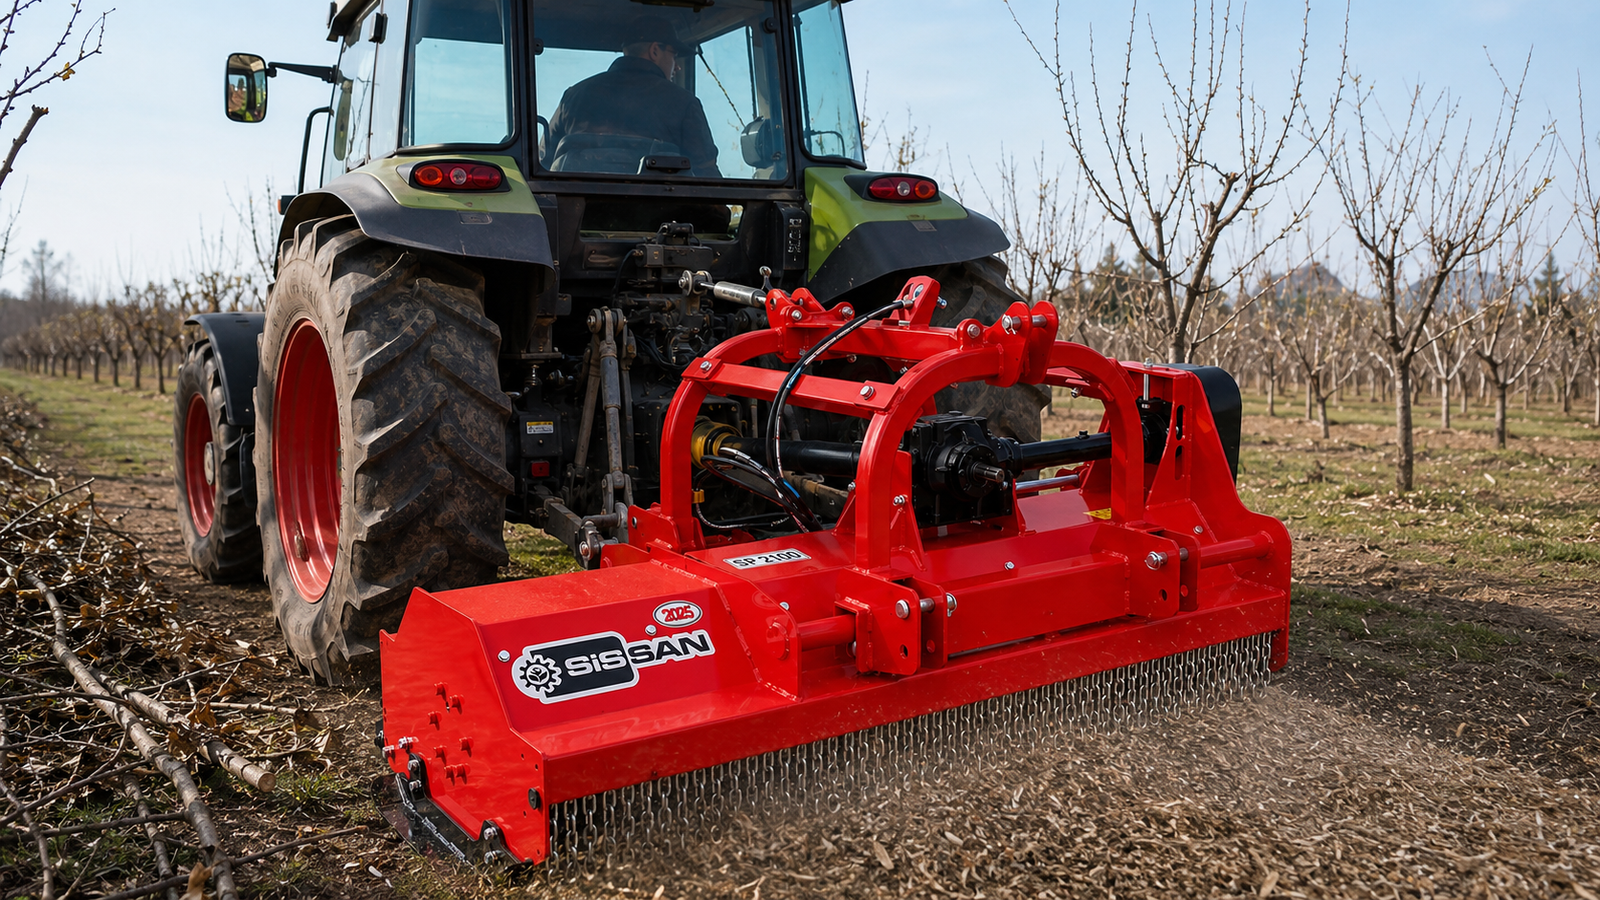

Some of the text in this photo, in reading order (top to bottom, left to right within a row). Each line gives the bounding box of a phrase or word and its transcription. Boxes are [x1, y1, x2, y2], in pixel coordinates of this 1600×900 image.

[732, 551, 802, 567] SP 2100
[661, 605, 695, 622] 2025
